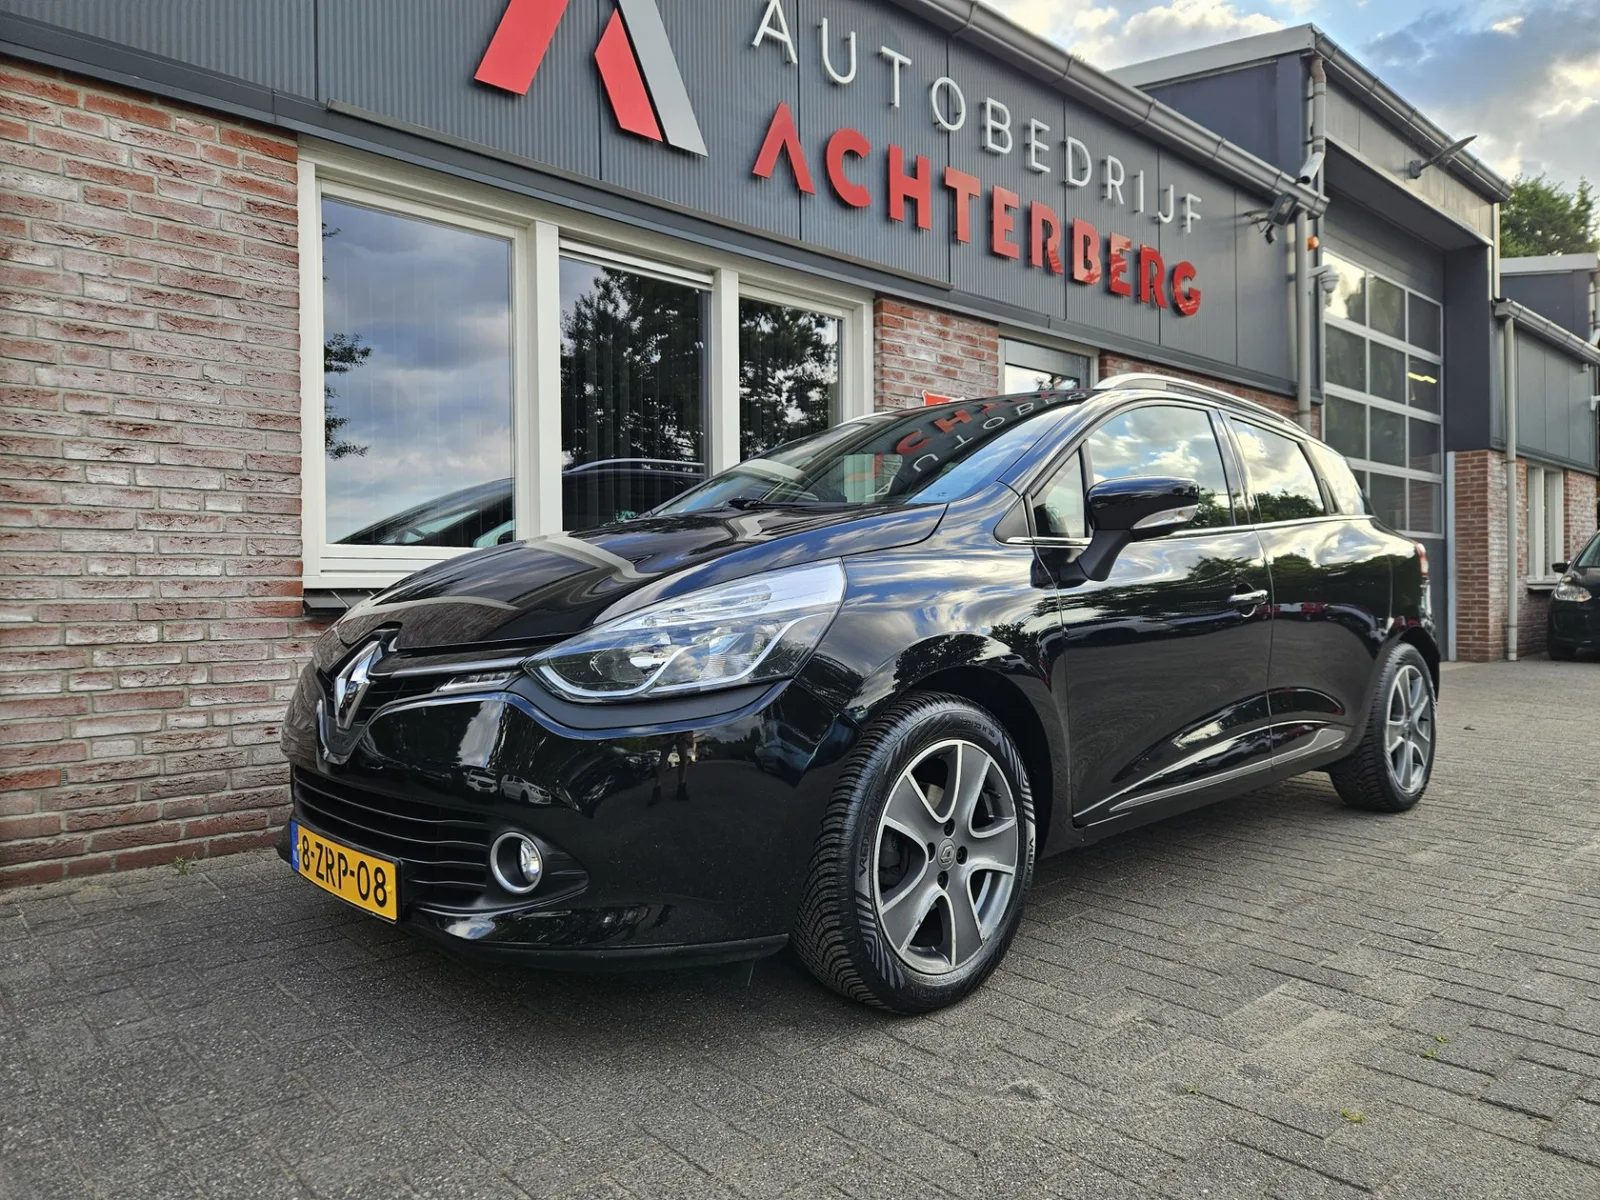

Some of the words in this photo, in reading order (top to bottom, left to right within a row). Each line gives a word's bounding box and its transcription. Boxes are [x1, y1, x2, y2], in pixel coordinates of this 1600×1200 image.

[750, 0, 1203, 234] AUTOBEDRIJF
[752, 101, 1202, 317] ACHTERBERG
[302, 834, 388, 909] 8-ZRP-08
